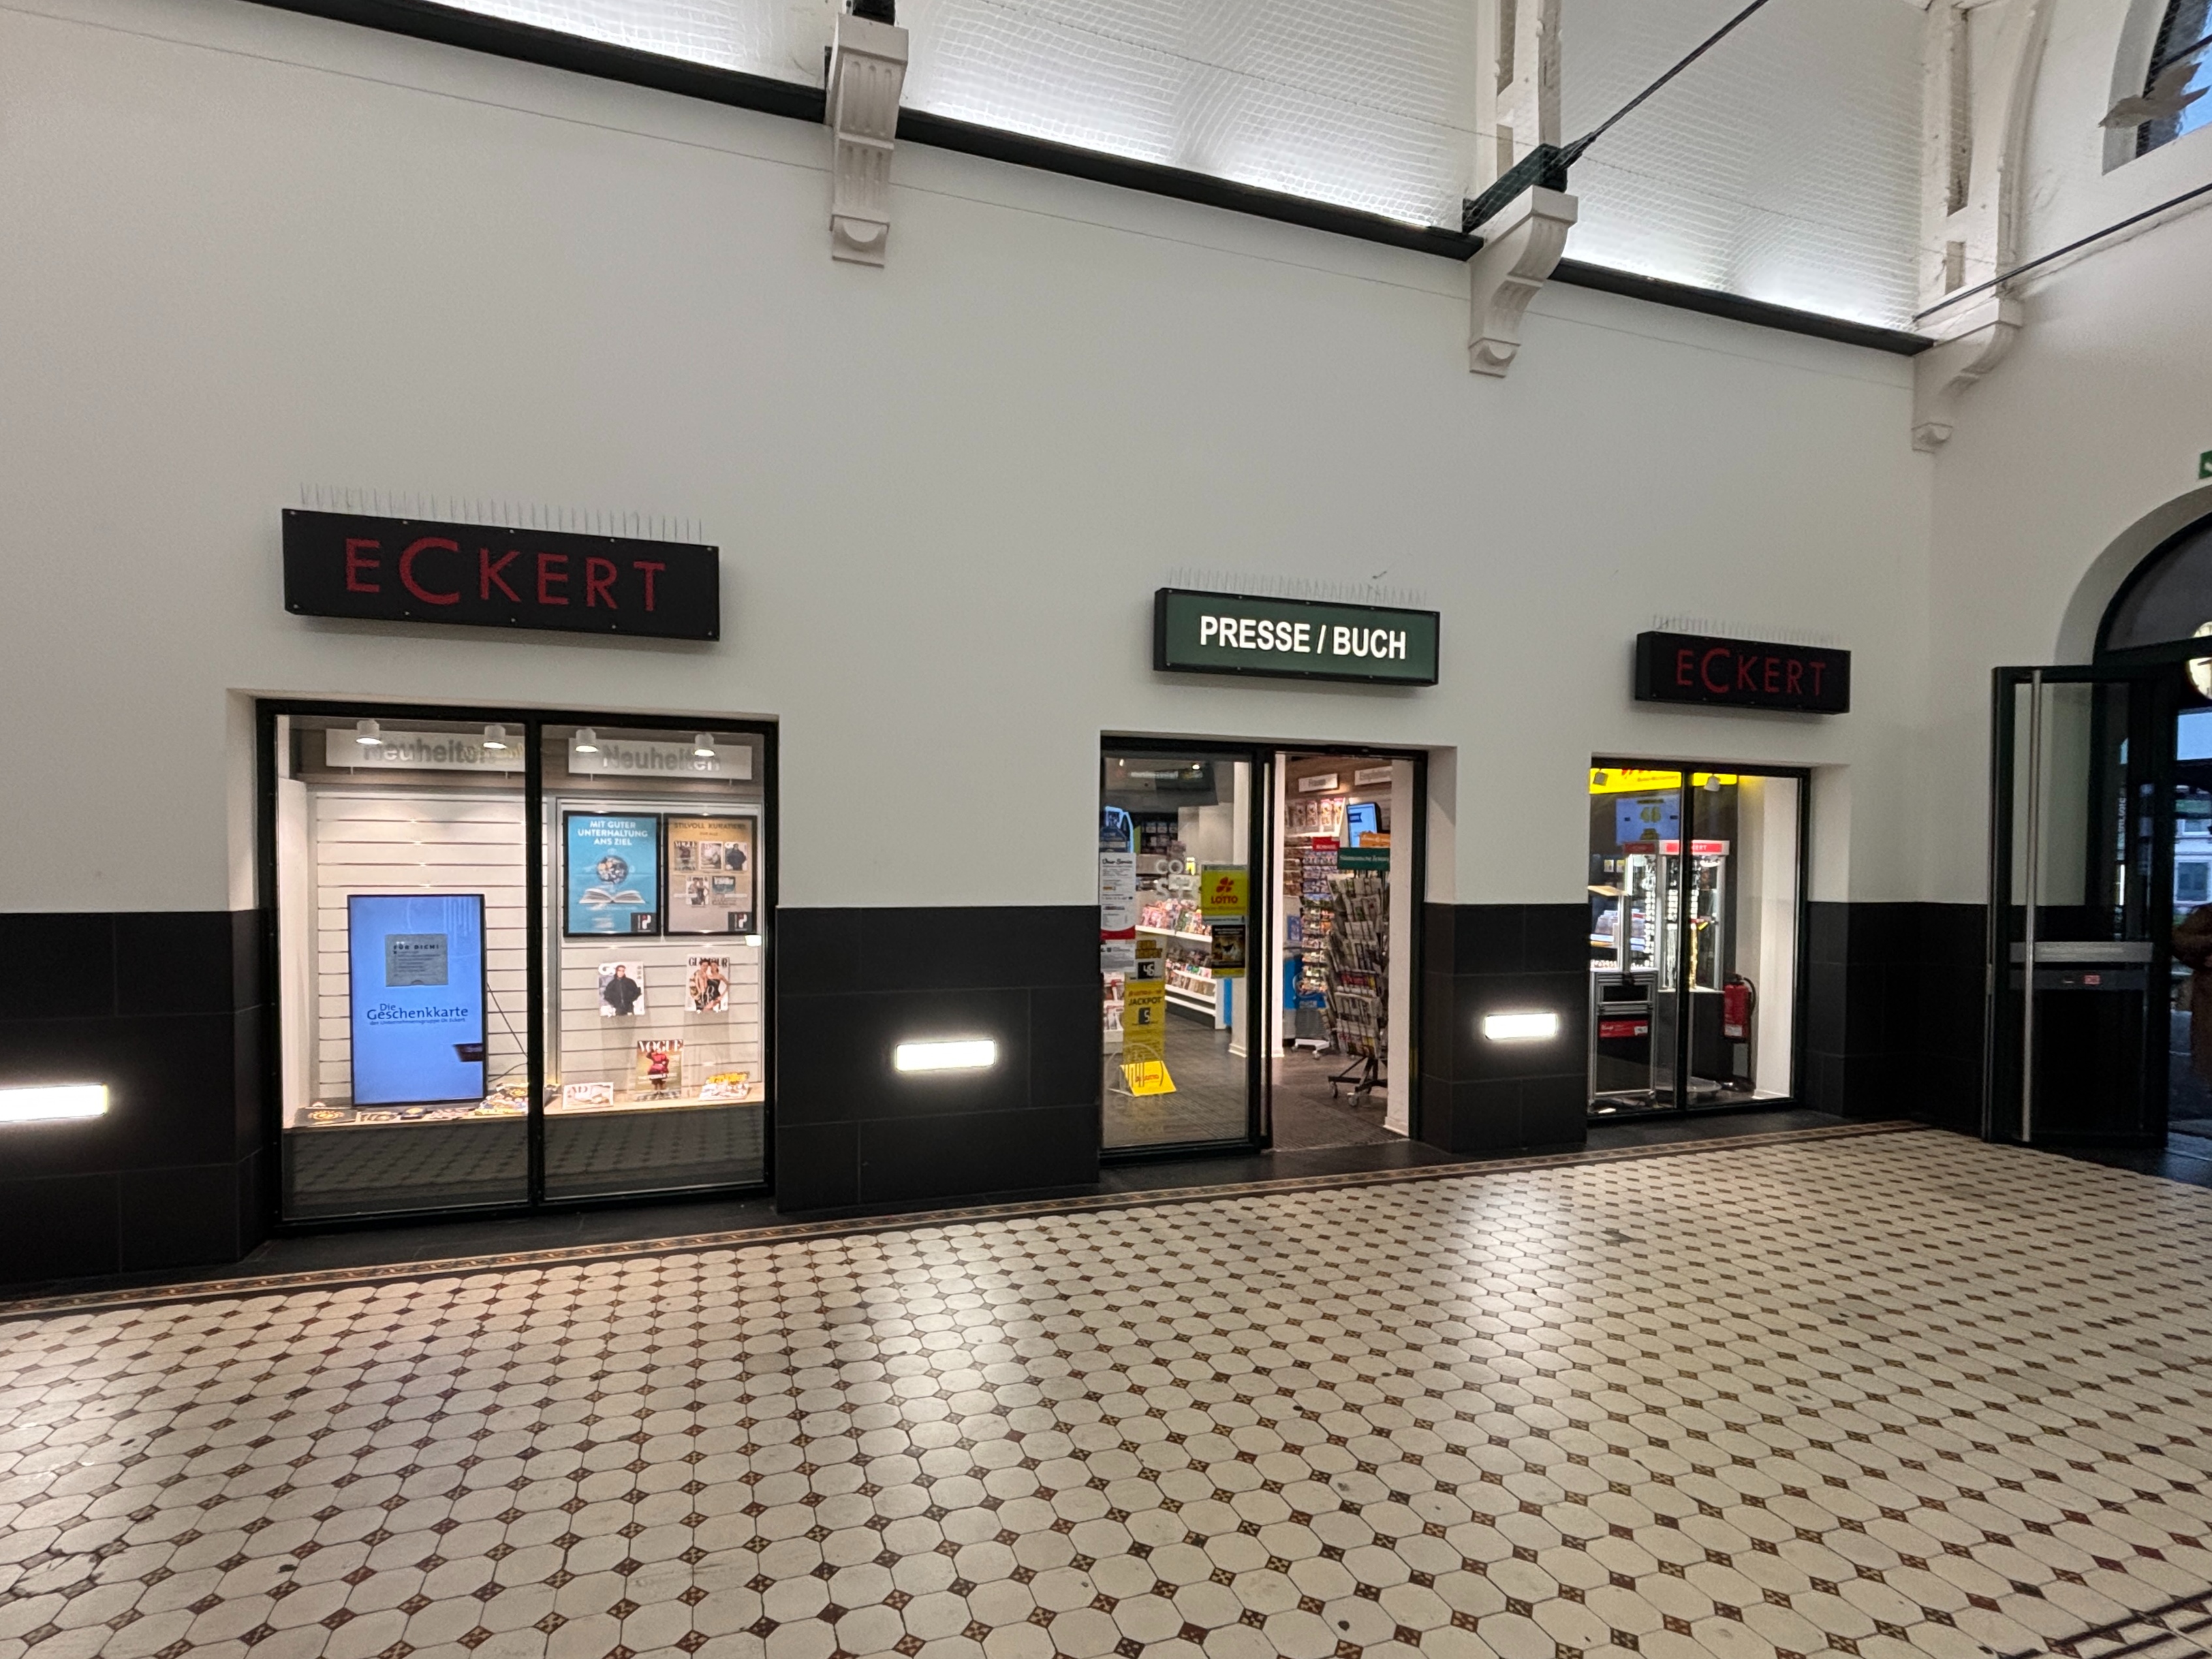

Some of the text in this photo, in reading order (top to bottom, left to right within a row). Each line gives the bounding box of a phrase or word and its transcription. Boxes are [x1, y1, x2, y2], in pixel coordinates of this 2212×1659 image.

[345, 537, 666, 612] ECKERT
[1200, 615, 1406, 659] PRESSE / BUCH
[1676, 648, 1826, 696] ECKERT
[578, 829, 648, 837] UNTERHALTUNG
[1129, 996, 1162, 1005] JACKPOT
[367, 1007, 469, 1020] Geschenkkarte
[639, 1040, 683, 1052] VOGUE
